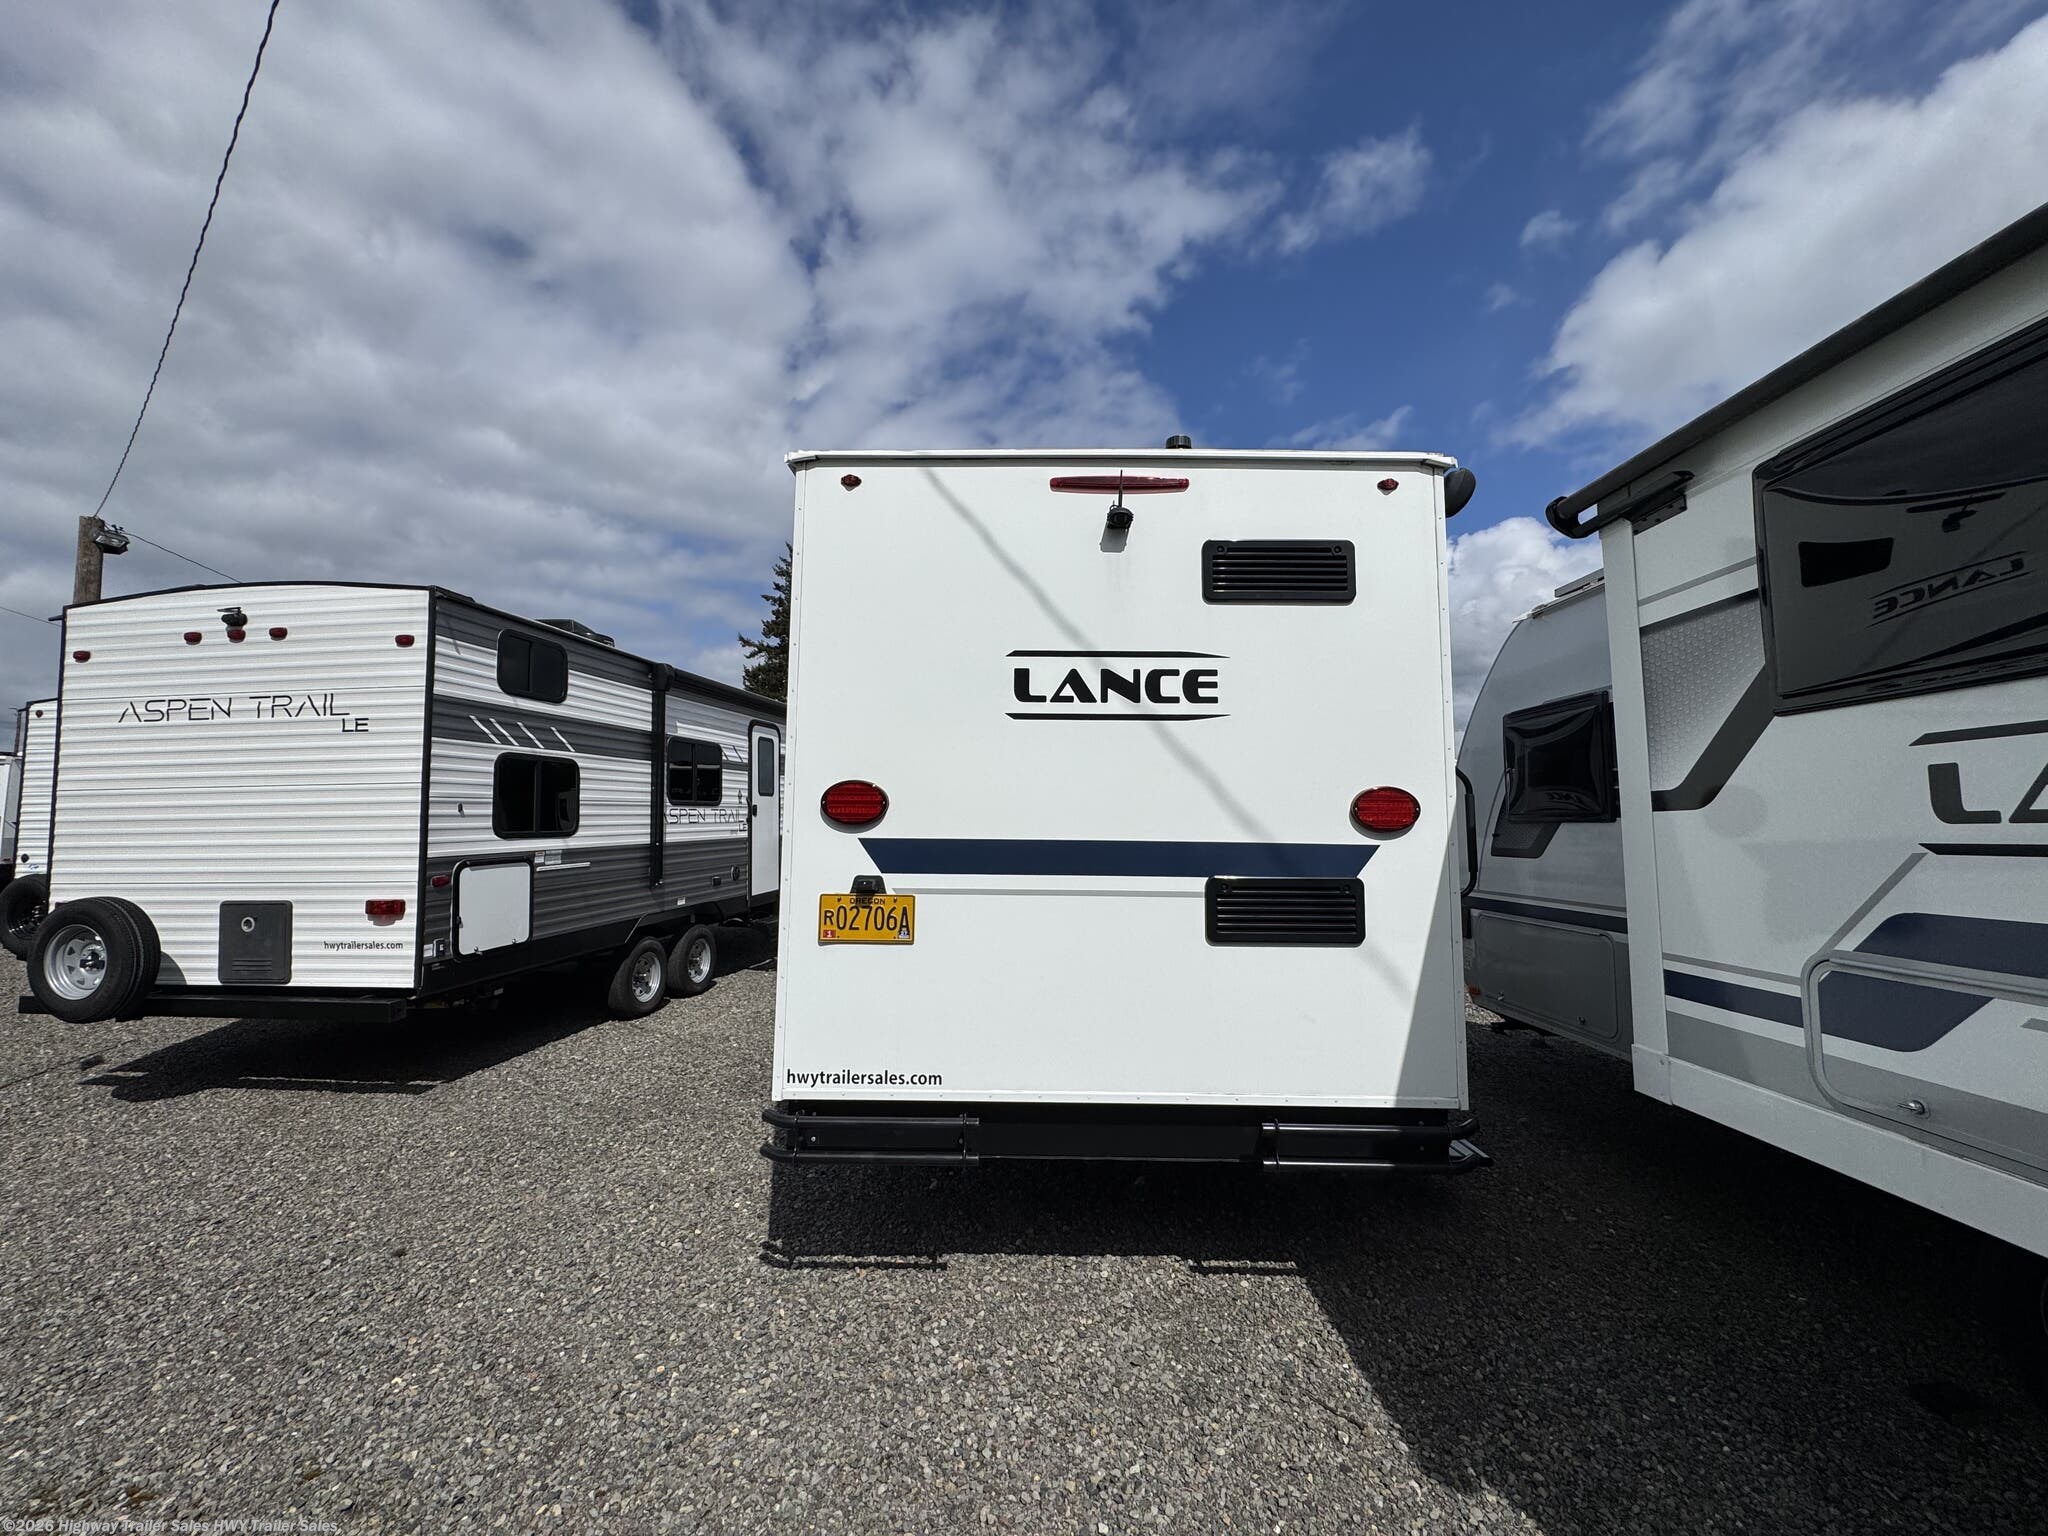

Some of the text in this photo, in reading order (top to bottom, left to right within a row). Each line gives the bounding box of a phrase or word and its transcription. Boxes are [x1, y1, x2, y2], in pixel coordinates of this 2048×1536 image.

[1013, 667, 1219, 704] LANCE
[118, 693, 350, 723] ASPEN TRAIL
[341, 718, 369, 733] LE
[711, 808, 745, 823] TRAIL
[823, 905, 910, 932] R02706A
[323, 941, 404, 952] hwytrailersales.com
[786, 1068, 943, 1088] hwytrailersales.com
